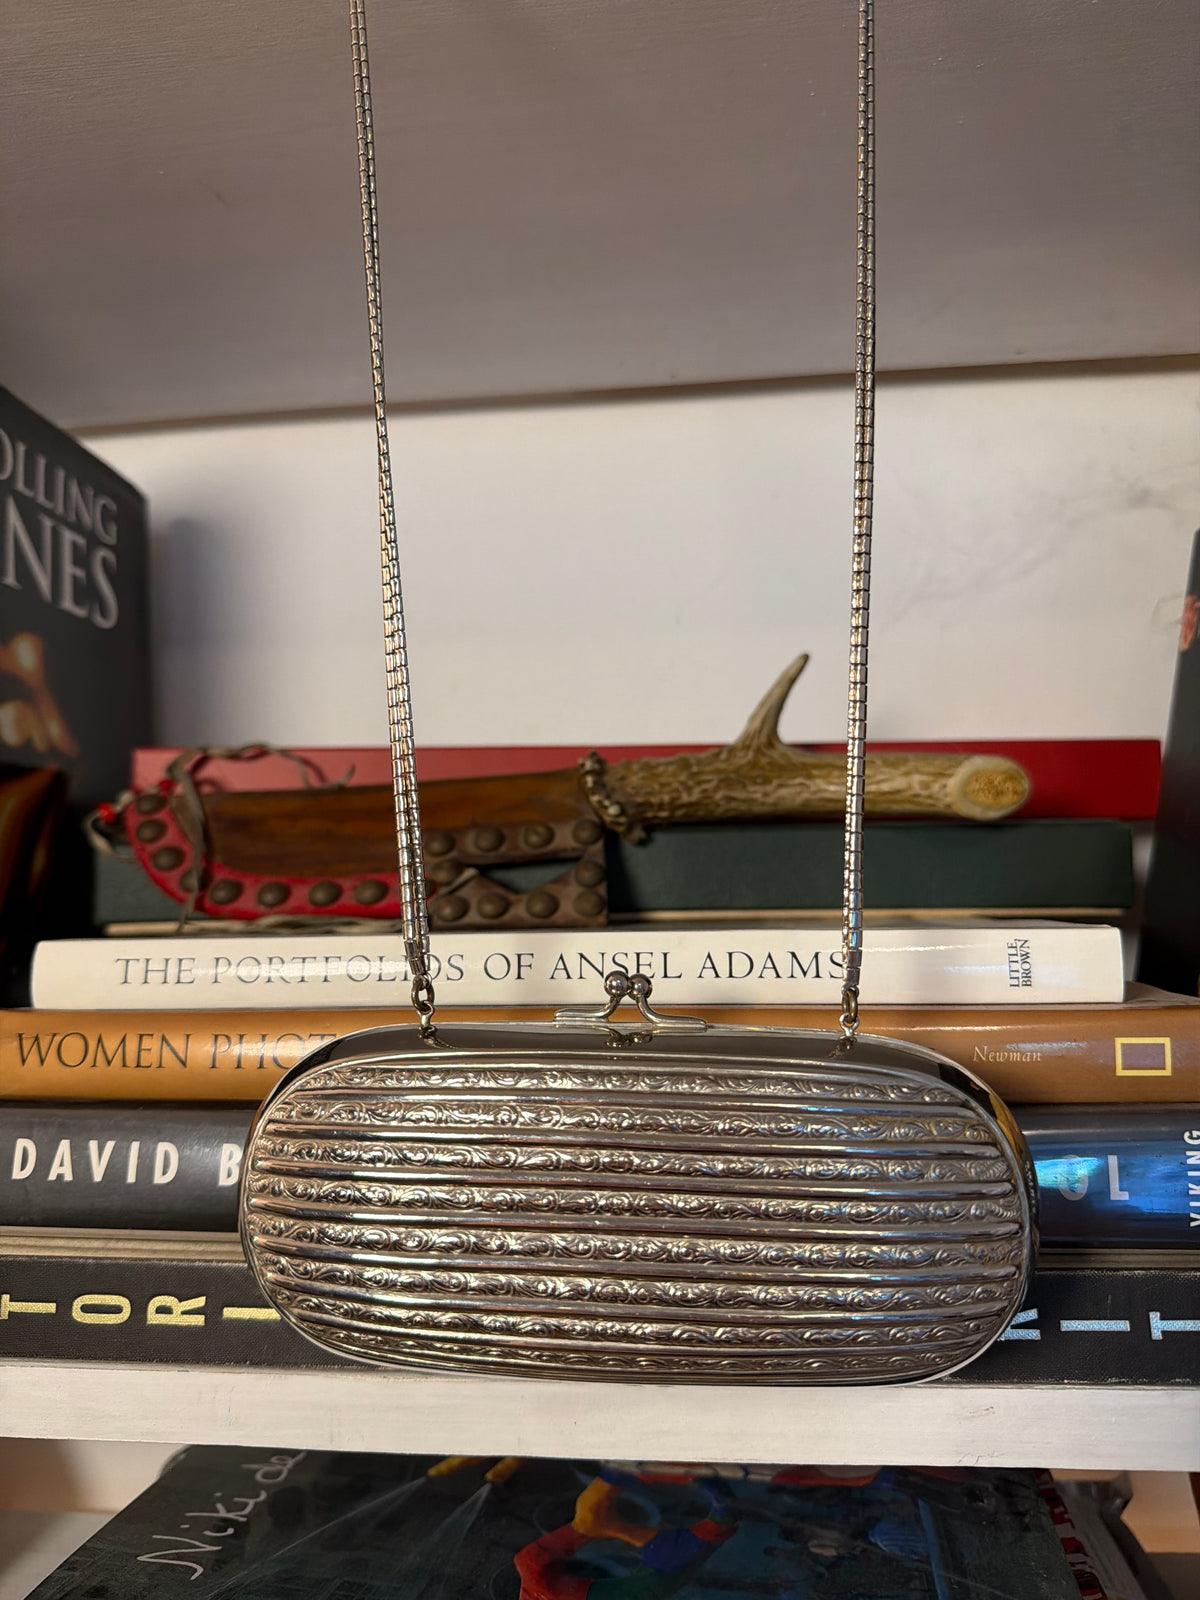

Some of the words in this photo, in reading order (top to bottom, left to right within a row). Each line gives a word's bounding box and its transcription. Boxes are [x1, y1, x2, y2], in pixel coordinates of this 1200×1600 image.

[0, 494, 119, 629] NES
[115, 957, 197, 985] THE
[483, 952, 535, 980] OF
[549, 951, 683, 980] ANSEL
[696, 950, 845, 979] ADAMS
[1018, 938, 1032, 988] BROWN
[17, 1032, 193, 1069] WOMEN
[972, 1045, 1041, 1063] Newman
[11, 1138, 180, 1184] DAVID
[137, 1490, 267, 1580] Niki
